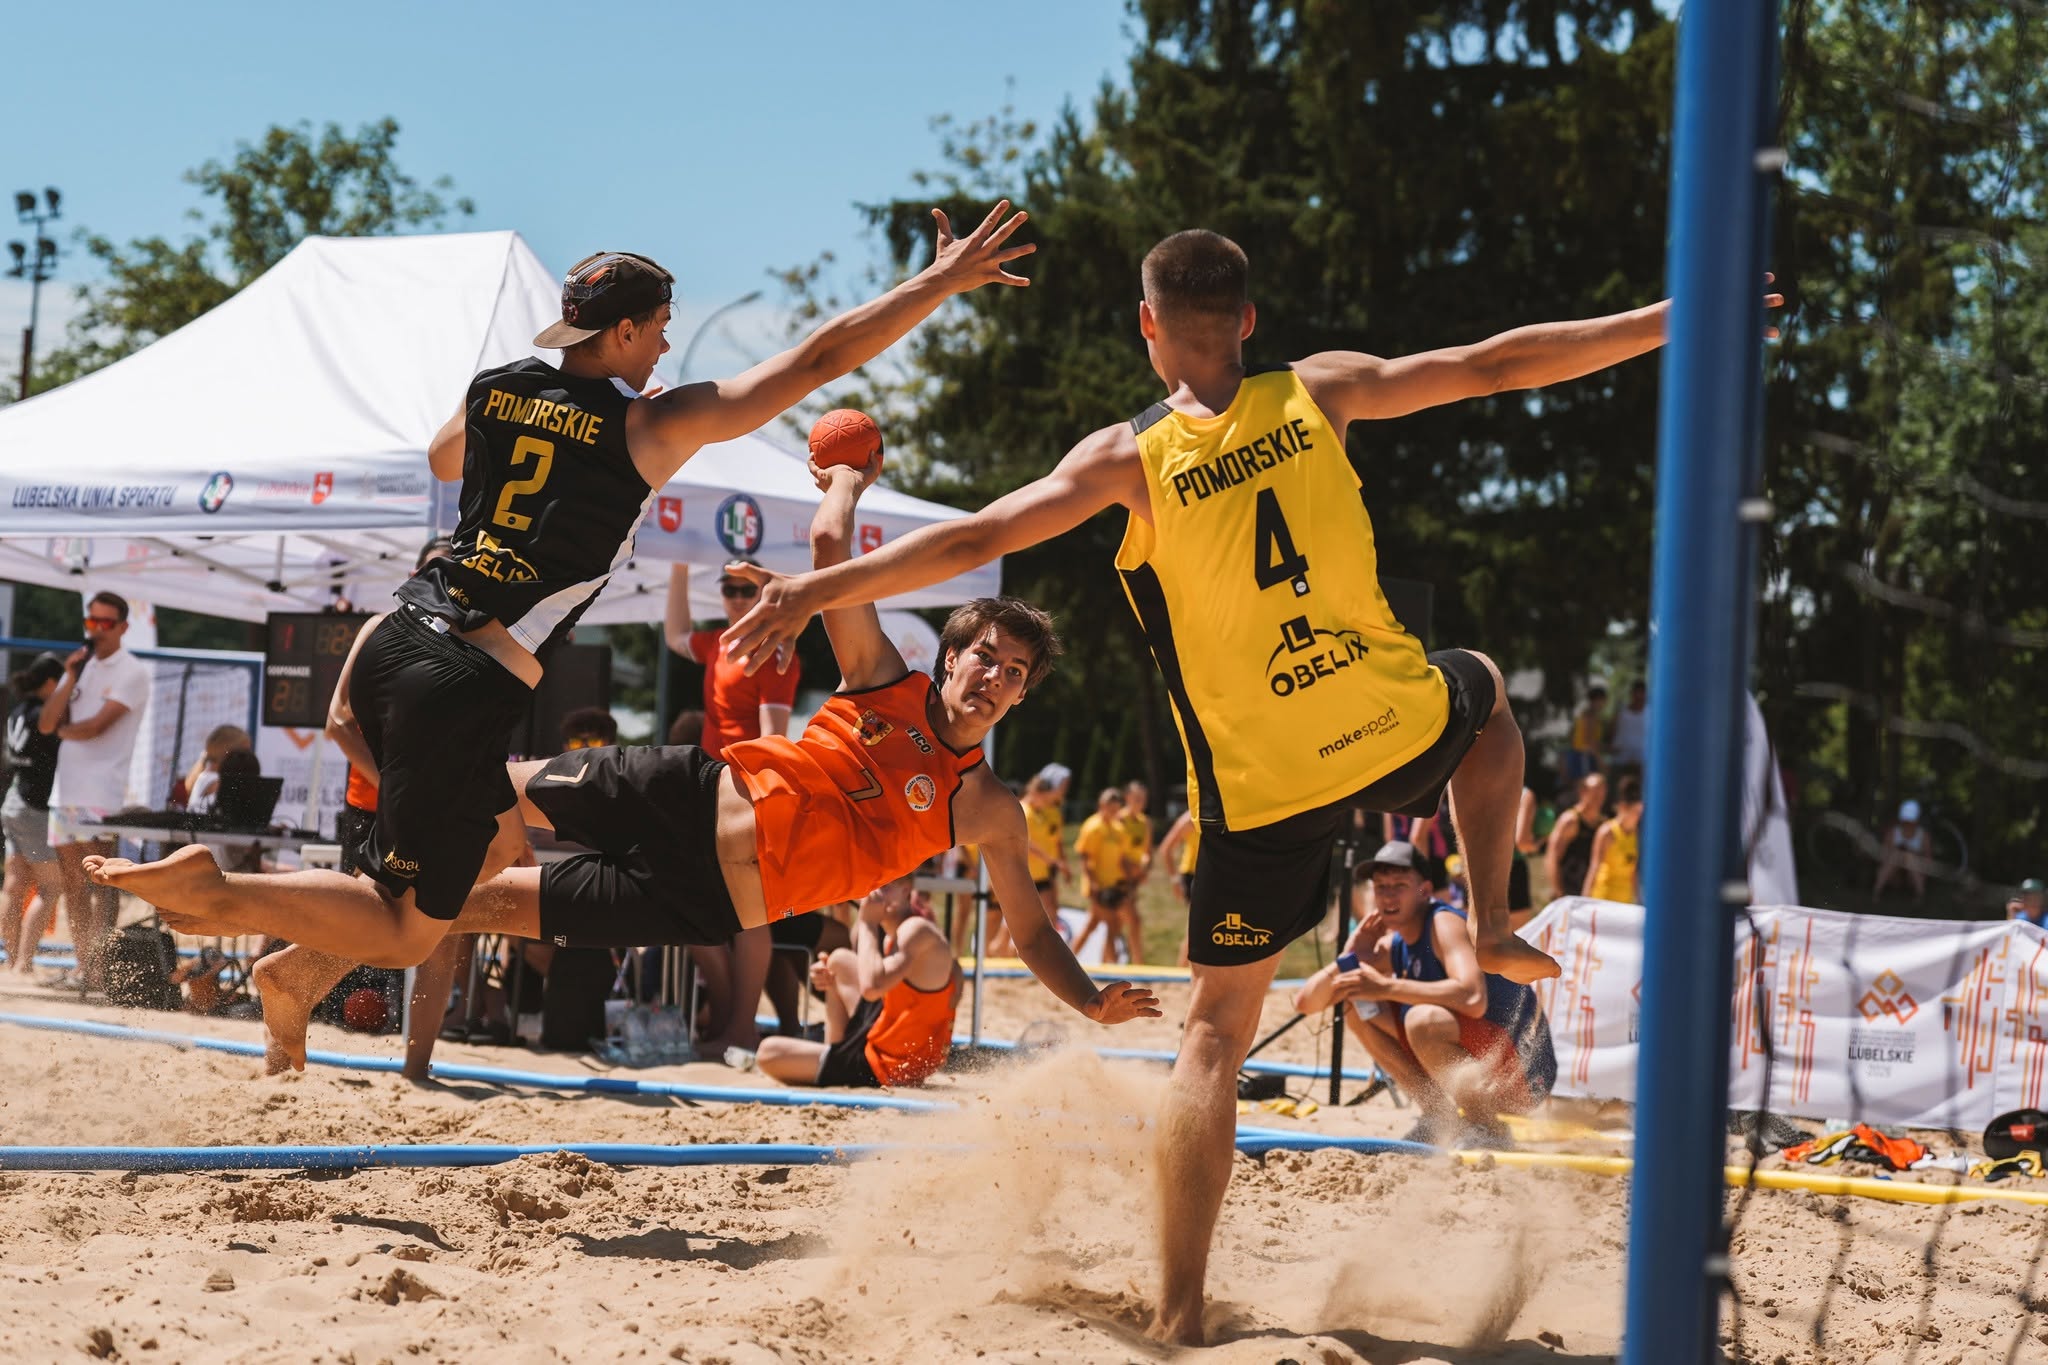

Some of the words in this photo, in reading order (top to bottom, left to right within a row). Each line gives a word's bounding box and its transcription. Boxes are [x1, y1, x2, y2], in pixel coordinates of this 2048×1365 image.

[484, 389, 604, 445] POMORSKIE
[492, 435, 555, 531] 2
[1172, 418, 1313, 507] POMORSKIE
[12, 484, 79, 508] LUBELSKA
[80, 484, 117, 508] UNIA
[117, 484, 177, 507] SPORTU
[723, 509, 758, 542] LUS
[1255, 487, 1311, 597] 4
[1271, 635, 1369, 697] OBELIX
[1318, 706, 1397, 759] makesport
[1211, 931, 1270, 946] OBELIX
[1848, 1046, 1914, 1063] LUBELSKIE
